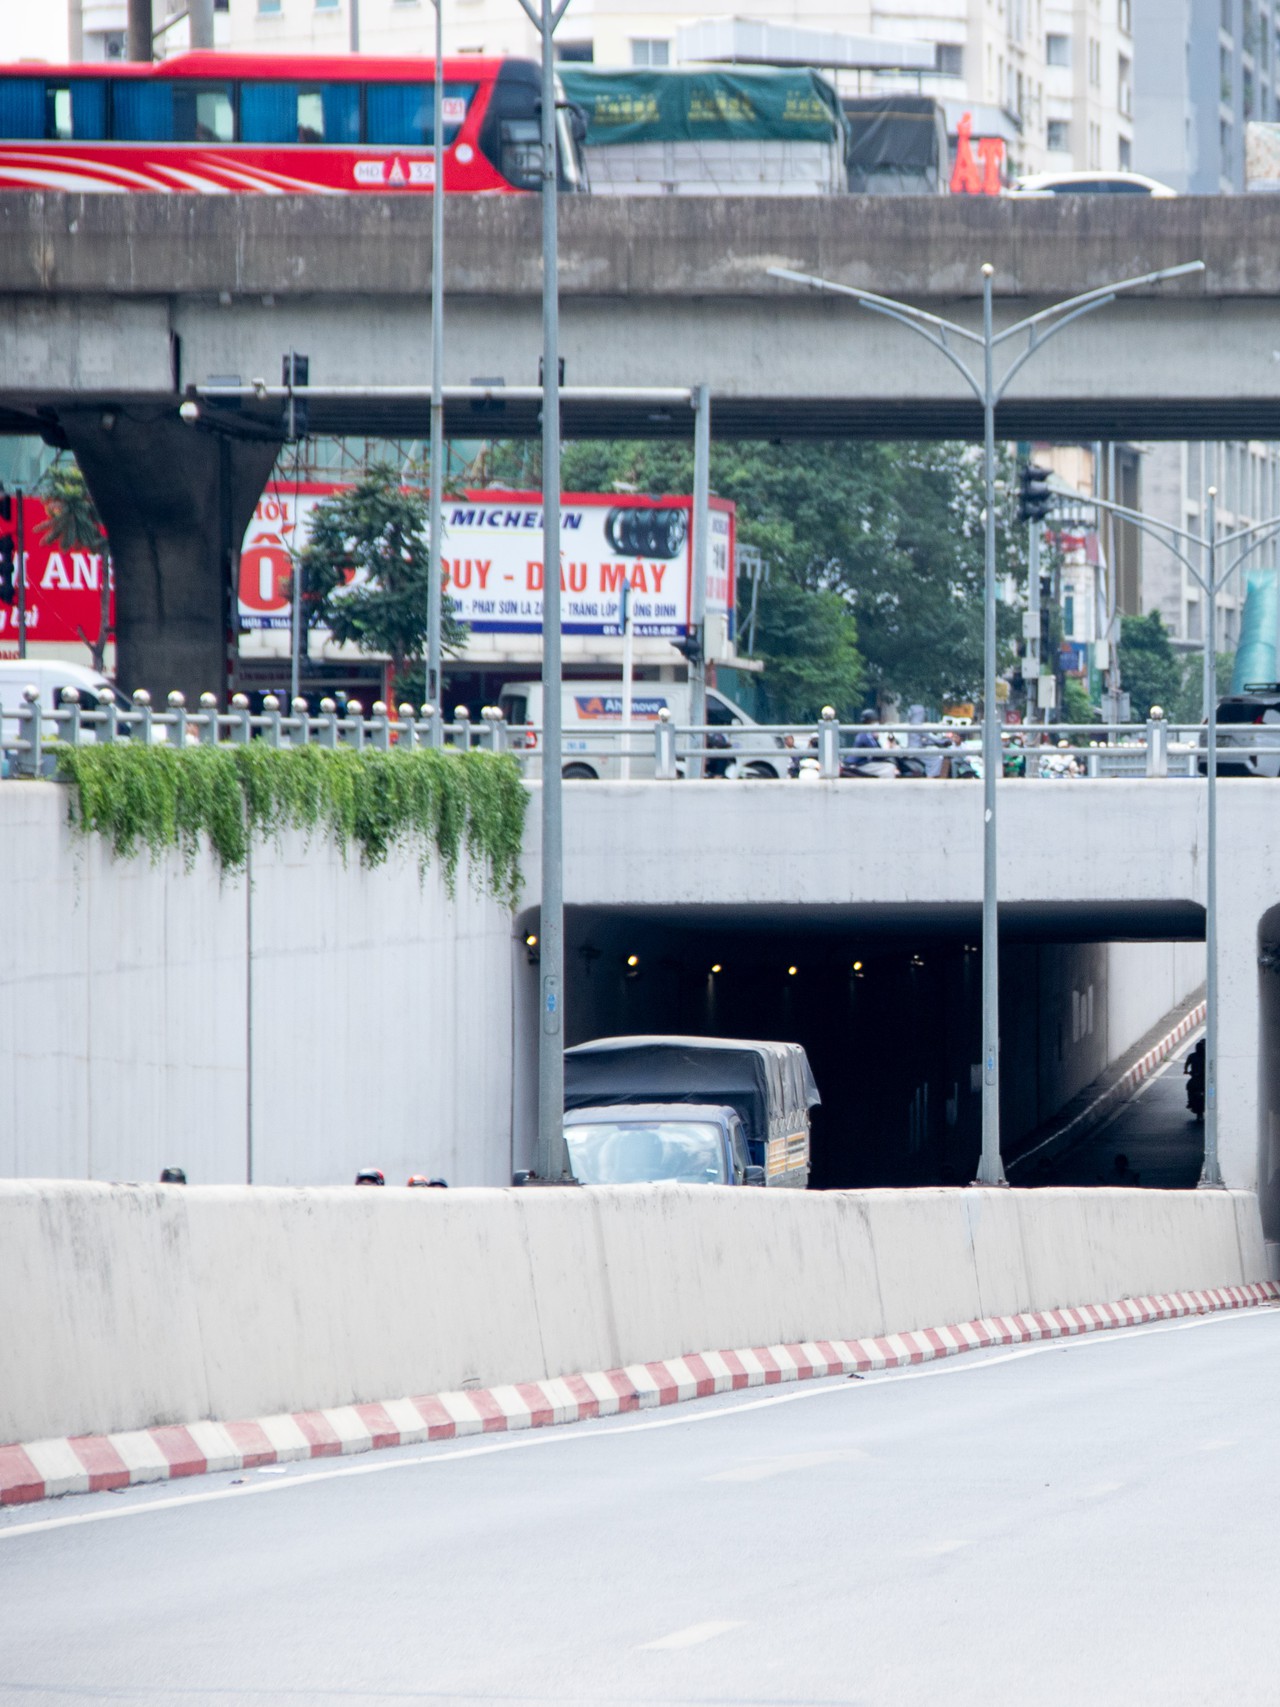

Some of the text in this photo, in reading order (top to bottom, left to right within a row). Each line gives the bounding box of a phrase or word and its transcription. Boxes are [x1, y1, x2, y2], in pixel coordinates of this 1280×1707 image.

[451, 508, 582, 530] MICHEN
[600, 555, 667, 593] MÁY
[604, 698, 660, 713] Ahmove
